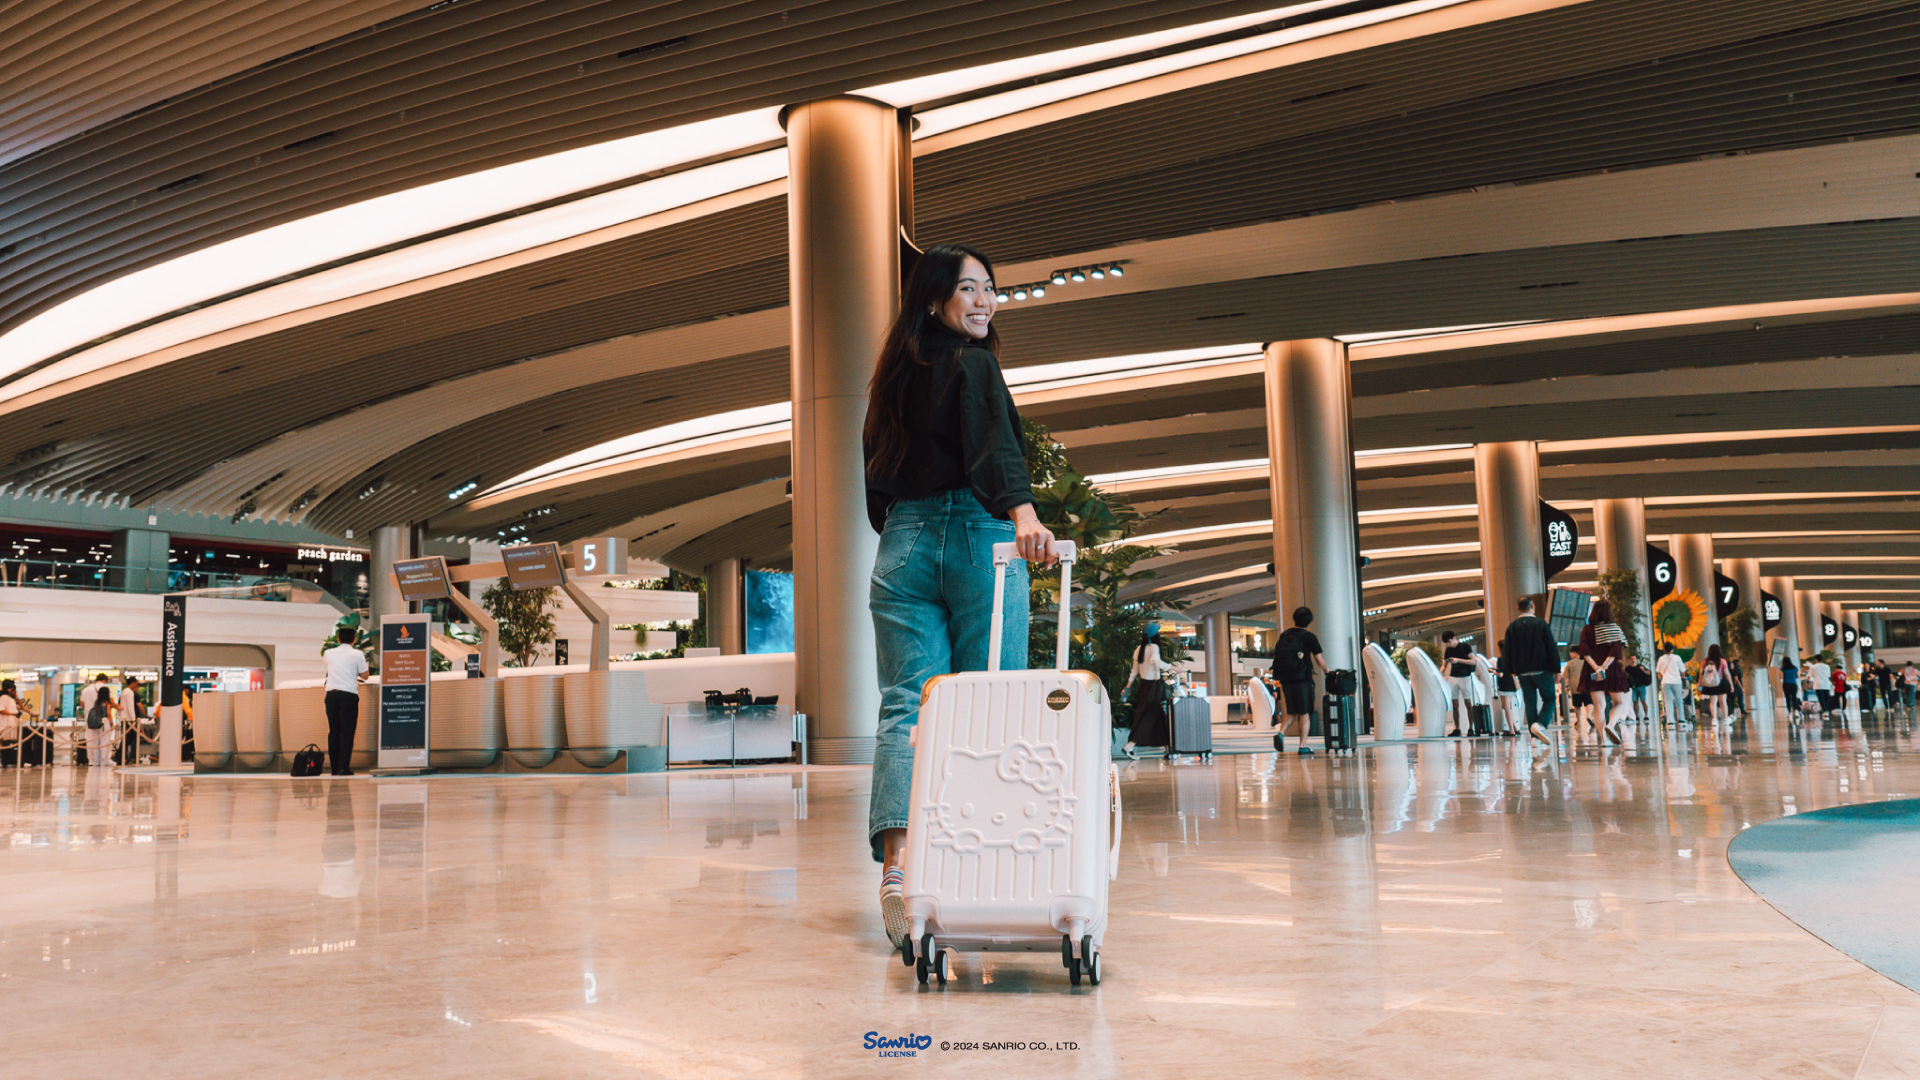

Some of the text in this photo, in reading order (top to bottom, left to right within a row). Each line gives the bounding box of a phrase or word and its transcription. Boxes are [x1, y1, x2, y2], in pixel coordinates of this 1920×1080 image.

[1550, 541, 1572, 551] FAST
[298, 547, 363, 562] peach garden
[584, 544, 596, 572] 5
[1654, 562, 1670, 582] 6
[1720, 586, 1734, 603] 7
[1825, 624, 1835, 636] 8
[1845, 631, 1854, 642] 9
[1859, 636, 1872, 647] 10
[166, 622, 178, 677] Assistance
